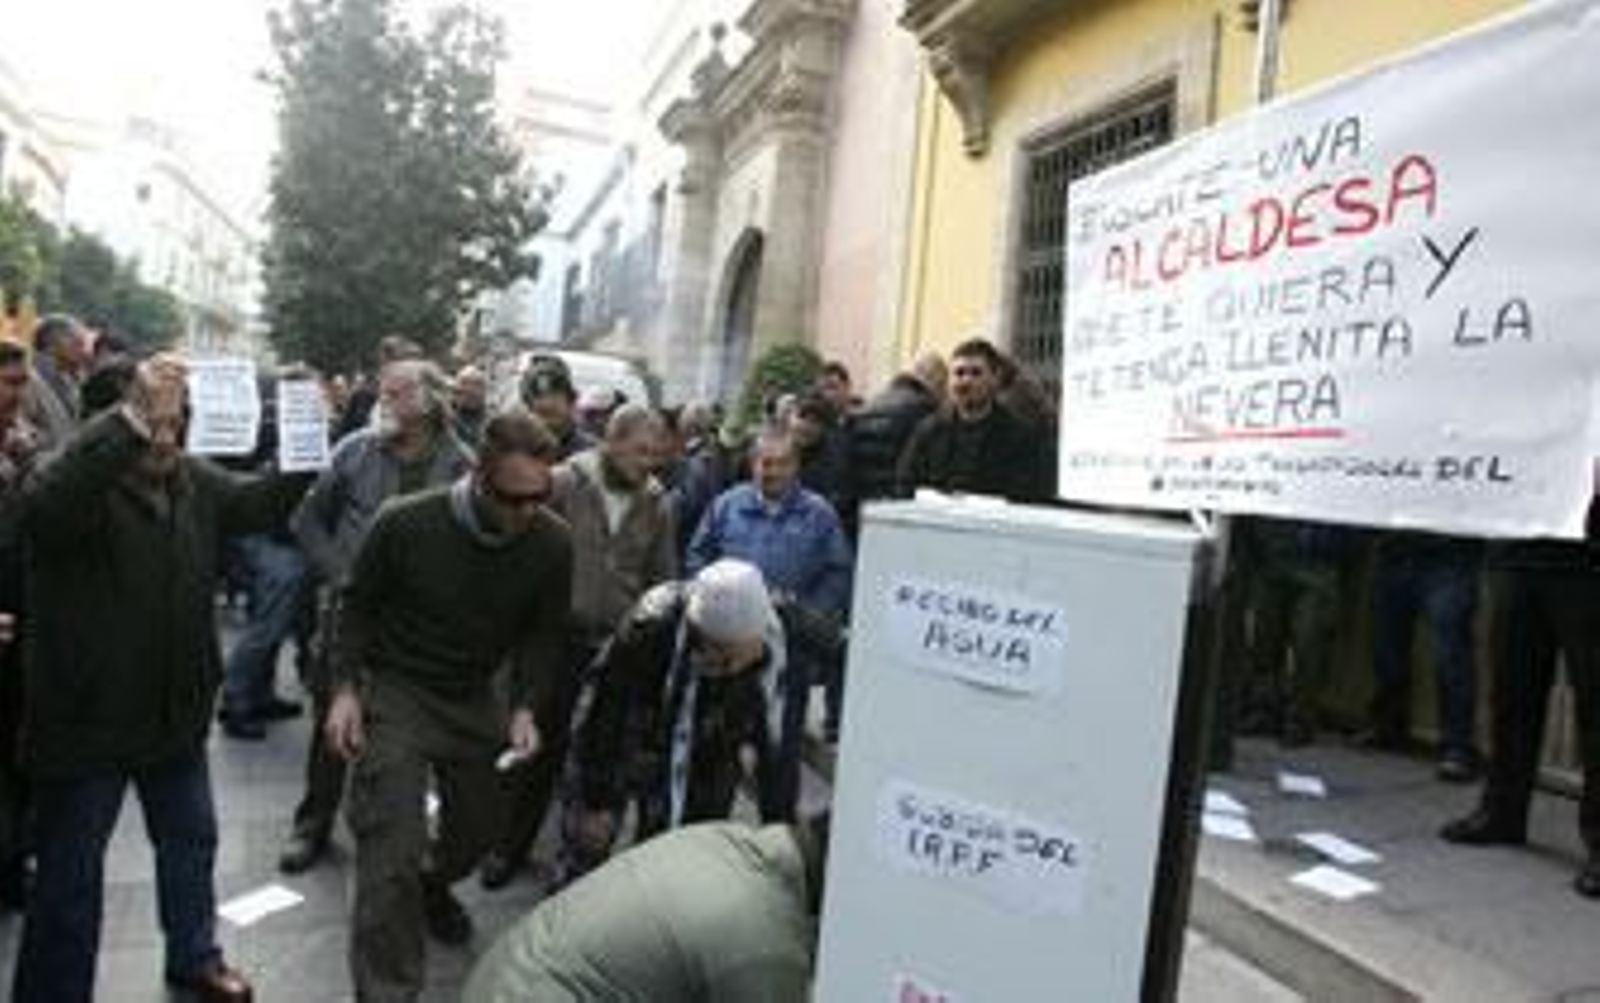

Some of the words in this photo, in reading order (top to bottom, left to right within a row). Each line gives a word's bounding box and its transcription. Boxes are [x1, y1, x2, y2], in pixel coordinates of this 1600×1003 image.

[1105, 154, 1437, 292] ALCALDESA
[1422, 226, 1478, 299] Y
[1455, 298, 1532, 345] LA
